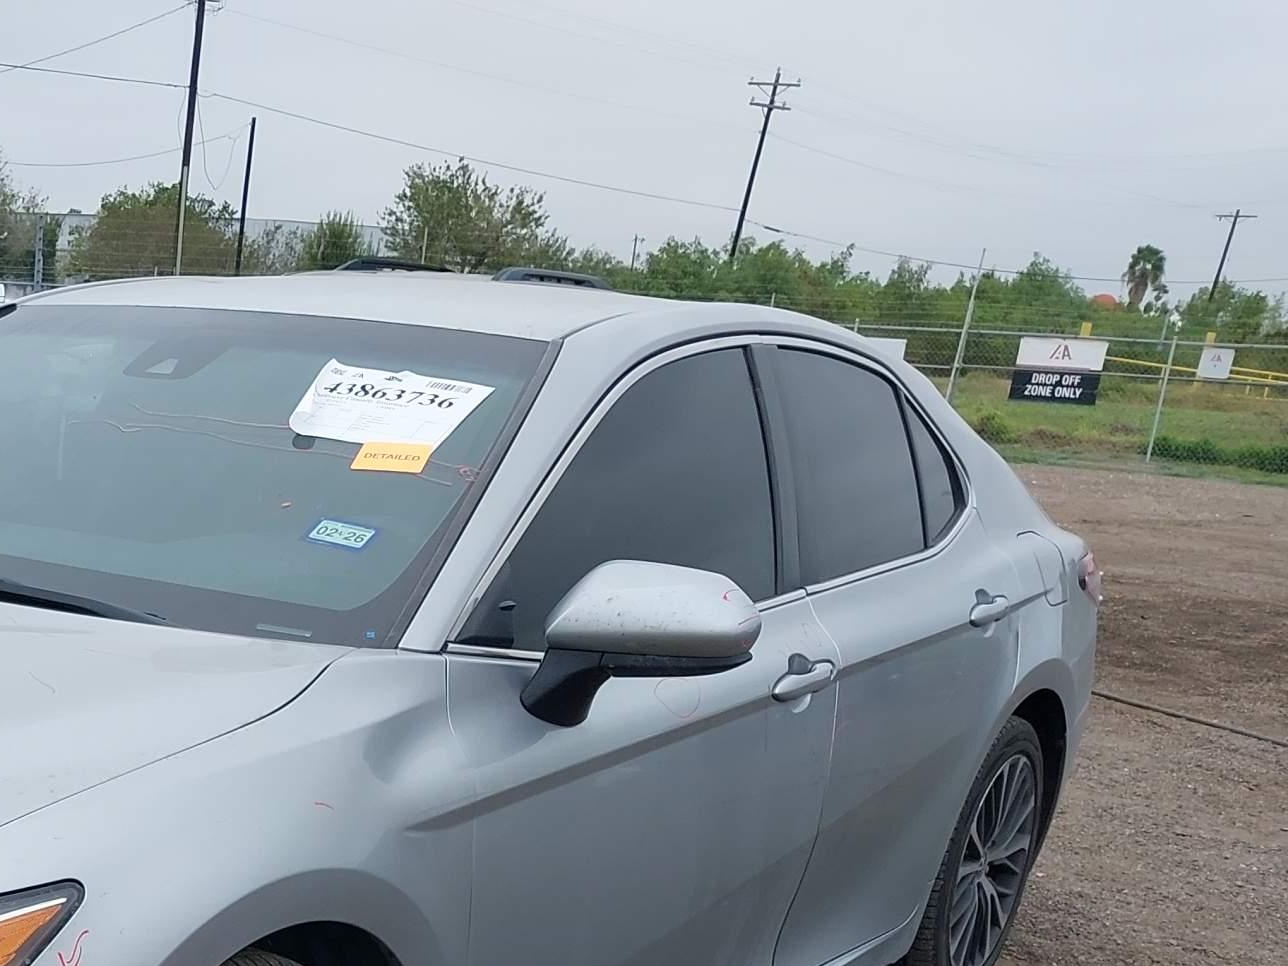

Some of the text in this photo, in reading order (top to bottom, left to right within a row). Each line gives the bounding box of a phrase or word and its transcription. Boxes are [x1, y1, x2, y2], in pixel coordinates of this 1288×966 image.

[1031, 372, 1082, 386] DROP OFF
[323, 380, 454, 409] 43863736
[1024, 384, 1083, 399] ZONE ONLY
[363, 451, 421, 463] DETAILED
